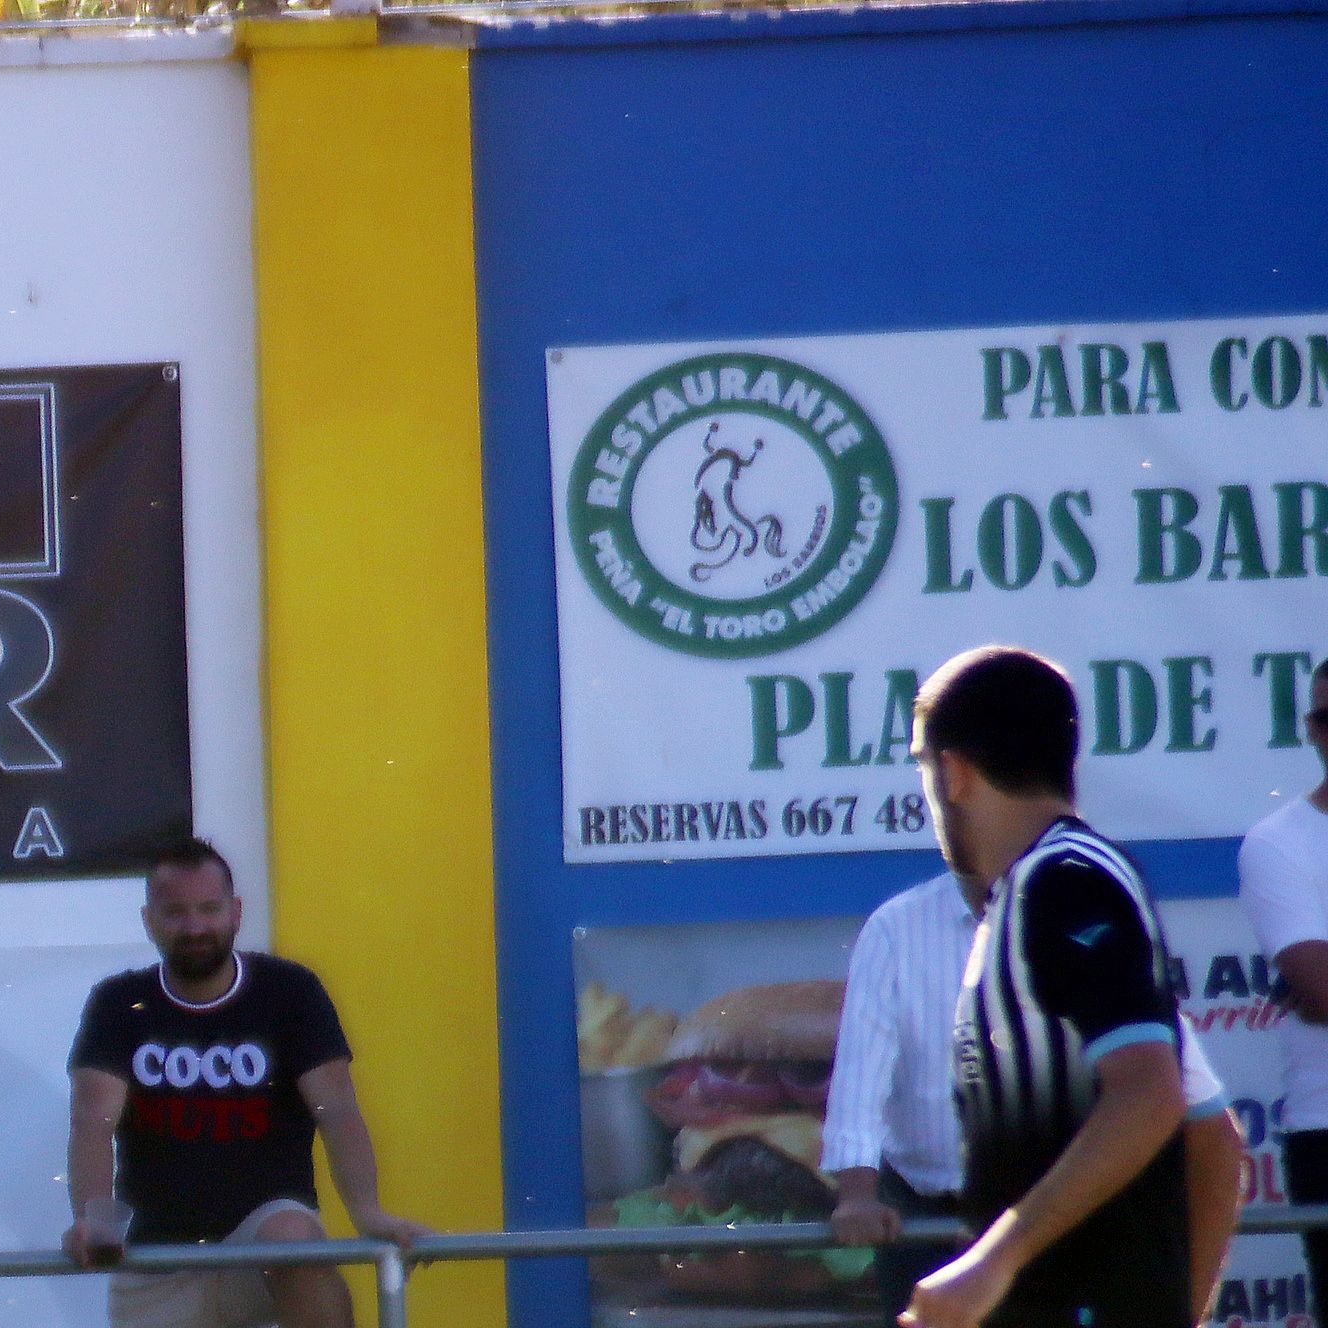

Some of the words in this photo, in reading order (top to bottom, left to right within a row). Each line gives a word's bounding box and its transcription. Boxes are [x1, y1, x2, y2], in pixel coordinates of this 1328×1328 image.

[980, 341, 1181, 421] PARA
[585, 366, 863, 508] RESTAURANTE
[588, 529, 642, 606] PEÑA
[702, 607, 788, 640] TORO
[919, 489, 1097, 595] LOS
[746, 668, 922, 771] PLA
[1089, 655, 1217, 757] DE
[578, 799, 769, 846] RESERVAS
[781, 795, 859, 838] 667
[132, 1042, 268, 1088] COCO
